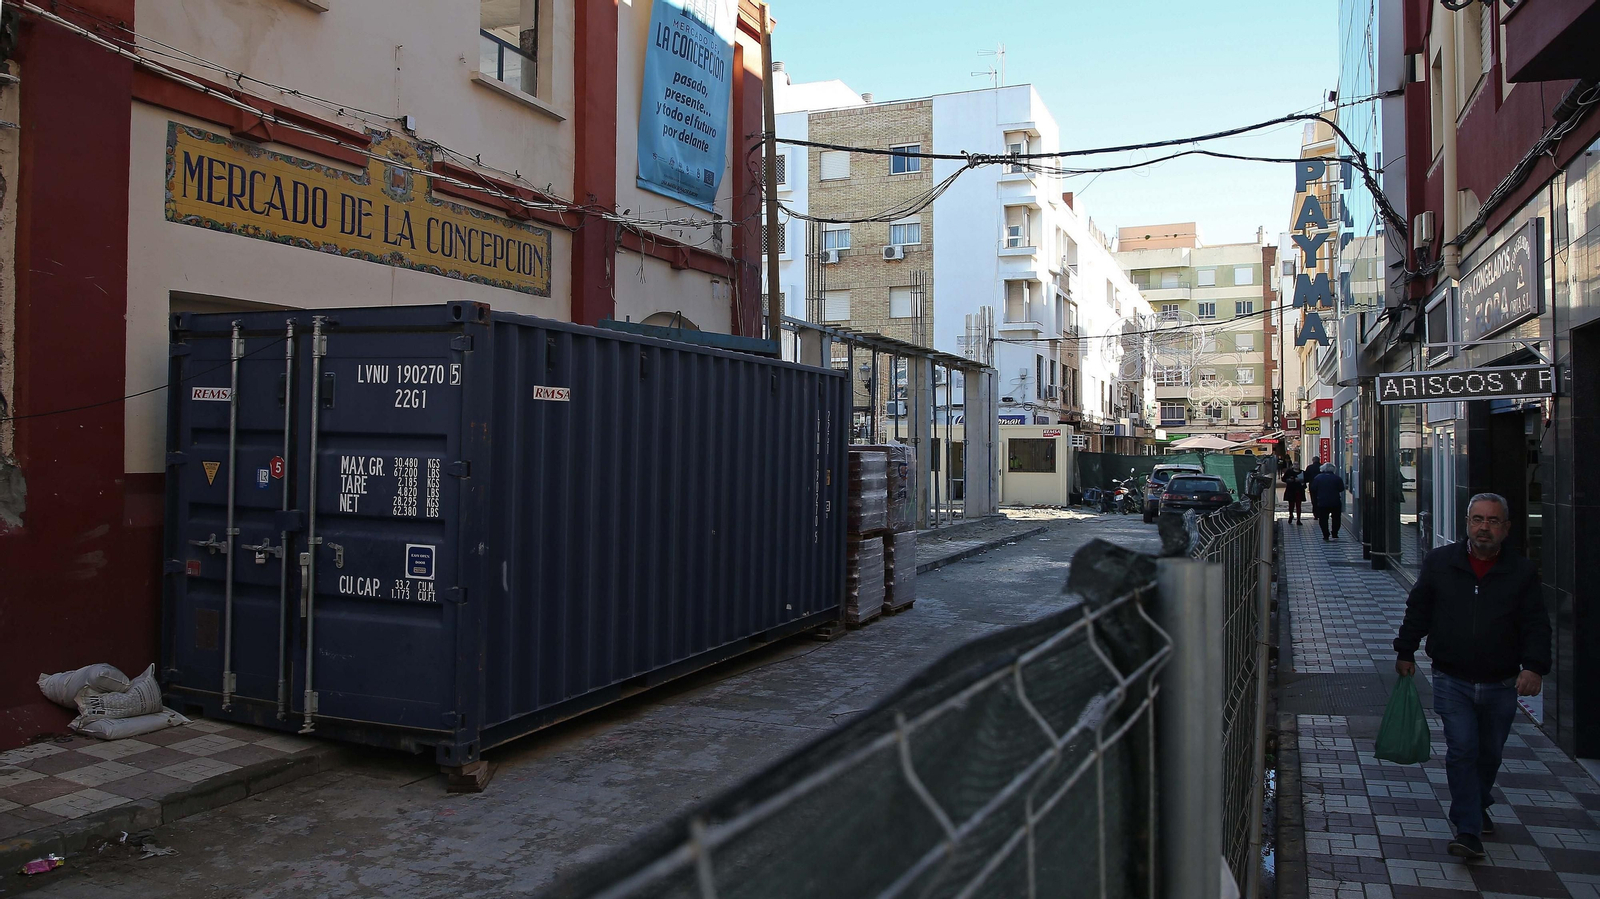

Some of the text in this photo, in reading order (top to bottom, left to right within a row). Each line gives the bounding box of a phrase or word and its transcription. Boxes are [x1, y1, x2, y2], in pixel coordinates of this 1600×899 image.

[656, 22, 670, 51] LA
[673, 19, 718, 52] MERCADO DE
[672, 71, 708, 98] pasado,
[664, 87, 711, 117] presente...
[656, 101, 717, 138] y todo el futuro
[662, 124, 709, 153] por delante
[182, 150, 544, 278] MERCADO DE LA CONCEPCION
[1291, 160, 1332, 346] PAYMA
[1472, 246, 1510, 296] CONGELADOS
[357, 364, 459, 384] LVNU 190270 5
[1383, 373, 1503, 397] ARISCOS
[1511, 371, 1527, 391] Y
[193, 388, 231, 400] REMS
[394, 388, 427, 408] 22G1
[275, 462, 282, 473] 5
[393, 467, 440, 478] 67.200 LBS
[394, 457, 418, 467] 30.480
[427, 458, 440, 468] KGS
[340, 474, 440, 494] TARE 2.185 KGS
[397, 487, 440, 498] 4.820 LBS
[339, 493, 439, 513] NET 28.295 KGS
[392, 506, 439, 518] 62.380 LBS
[391, 588, 410, 600] 1.173
[395, 579, 410, 590] 33.2
